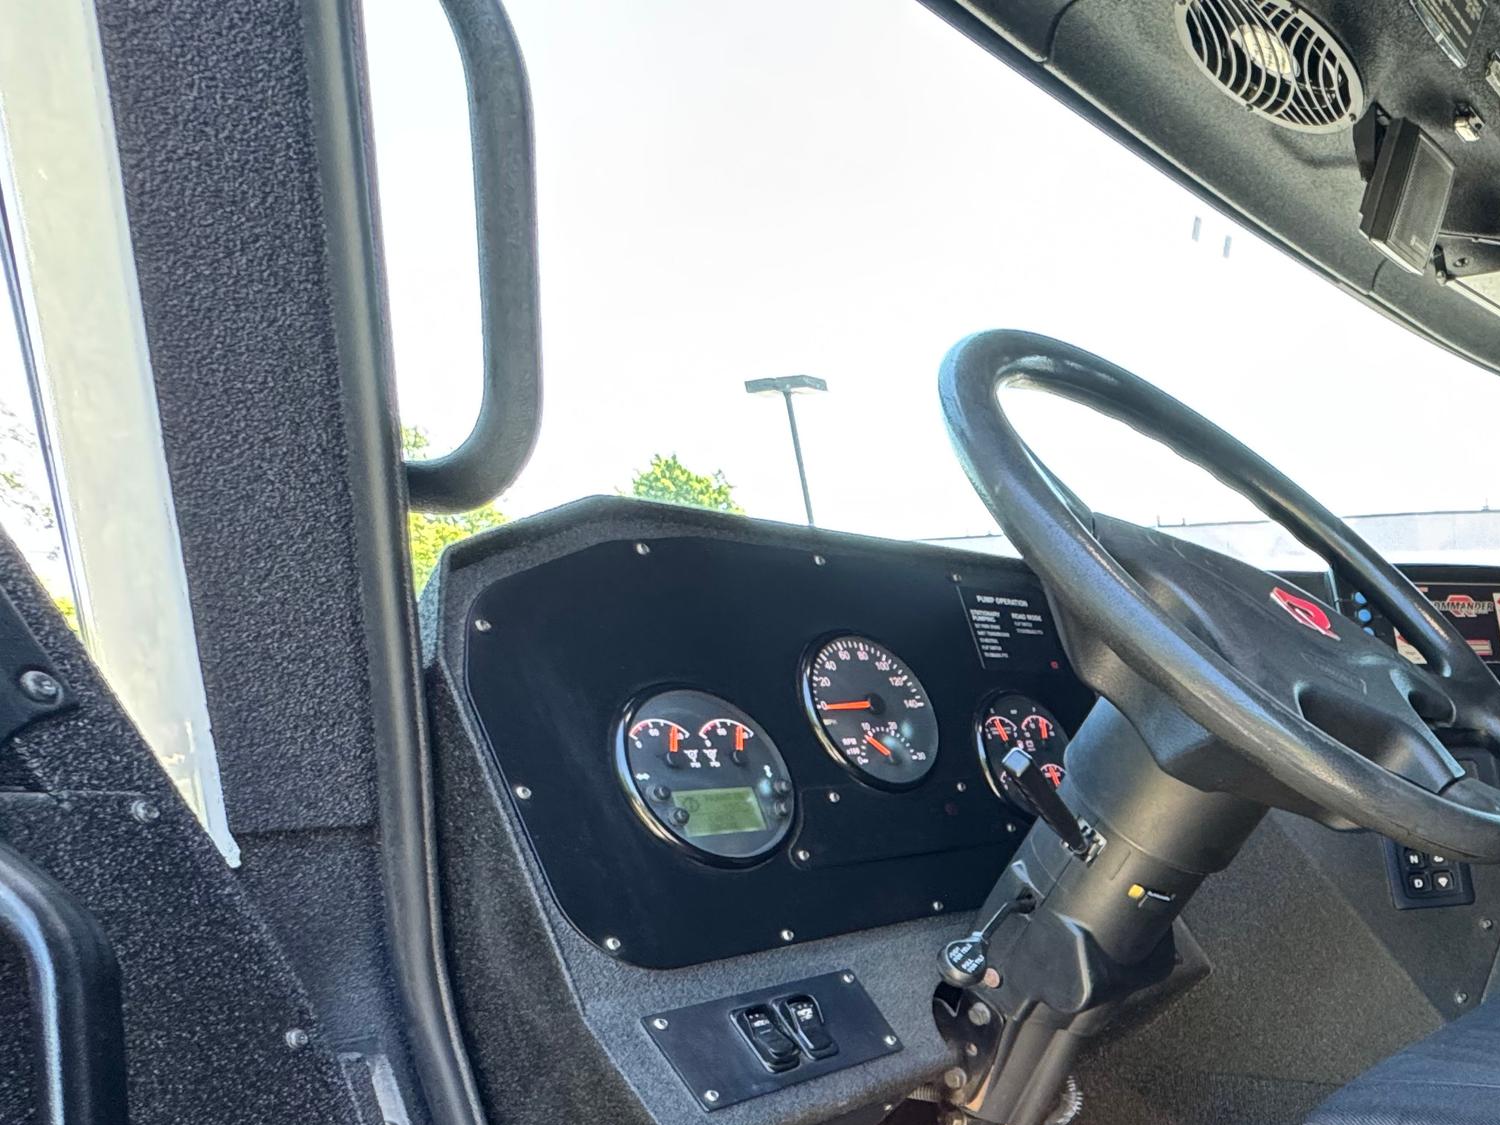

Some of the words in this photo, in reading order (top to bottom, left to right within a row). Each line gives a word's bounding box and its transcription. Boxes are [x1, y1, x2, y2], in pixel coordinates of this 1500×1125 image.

[996, 597, 1028, 607] OPERATION
[1433, 601, 1494, 610] OMMANDER
[838, 650, 850, 660] 60
[857, 650, 868, 660] 80
[825, 661, 836, 671] 40
[875, 661, 889, 671] 100
[820, 677, 831, 686] 20
[889, 677, 904, 686] 120
[904, 699, 918, 708] 140
[861, 722, 870, 731] 10
[888, 722, 897, 730] 20
[916, 752, 926, 760] 30
[1410, 855, 1418, 864] N
[1414, 879, 1423, 888] D
